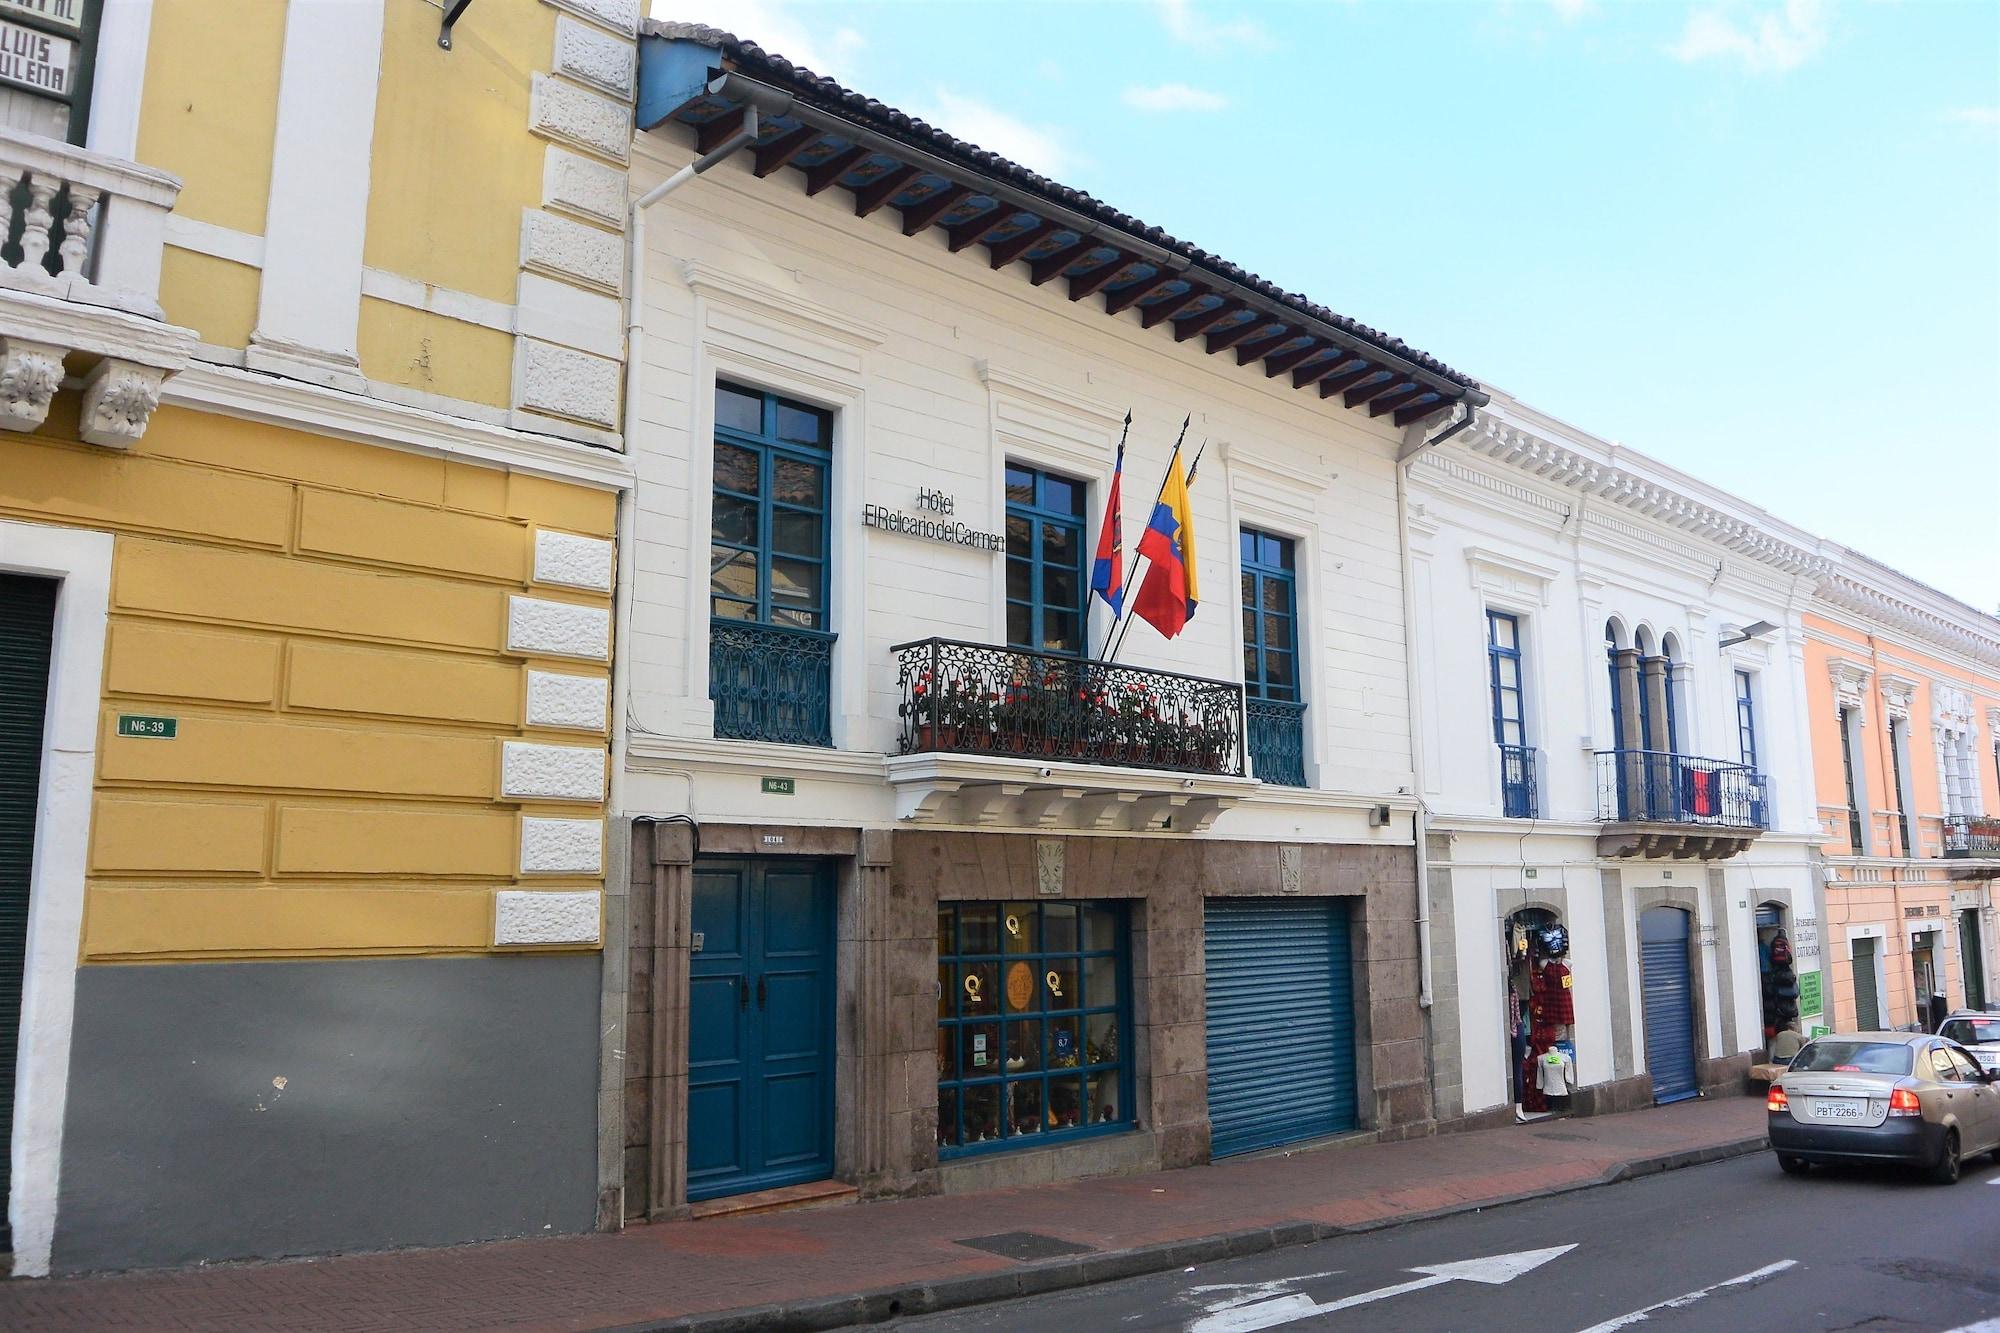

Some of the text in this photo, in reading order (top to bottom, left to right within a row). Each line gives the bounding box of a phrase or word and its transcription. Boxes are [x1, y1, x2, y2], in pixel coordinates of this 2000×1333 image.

[1, 26, 50, 63] LUIS
[920, 486, 954, 516] Hotel
[864, 503, 1005, 552] El Relicario del Carmen
[131, 720, 165, 733] N6-39
[1816, 1107, 1857, 1118] PBT-2266
